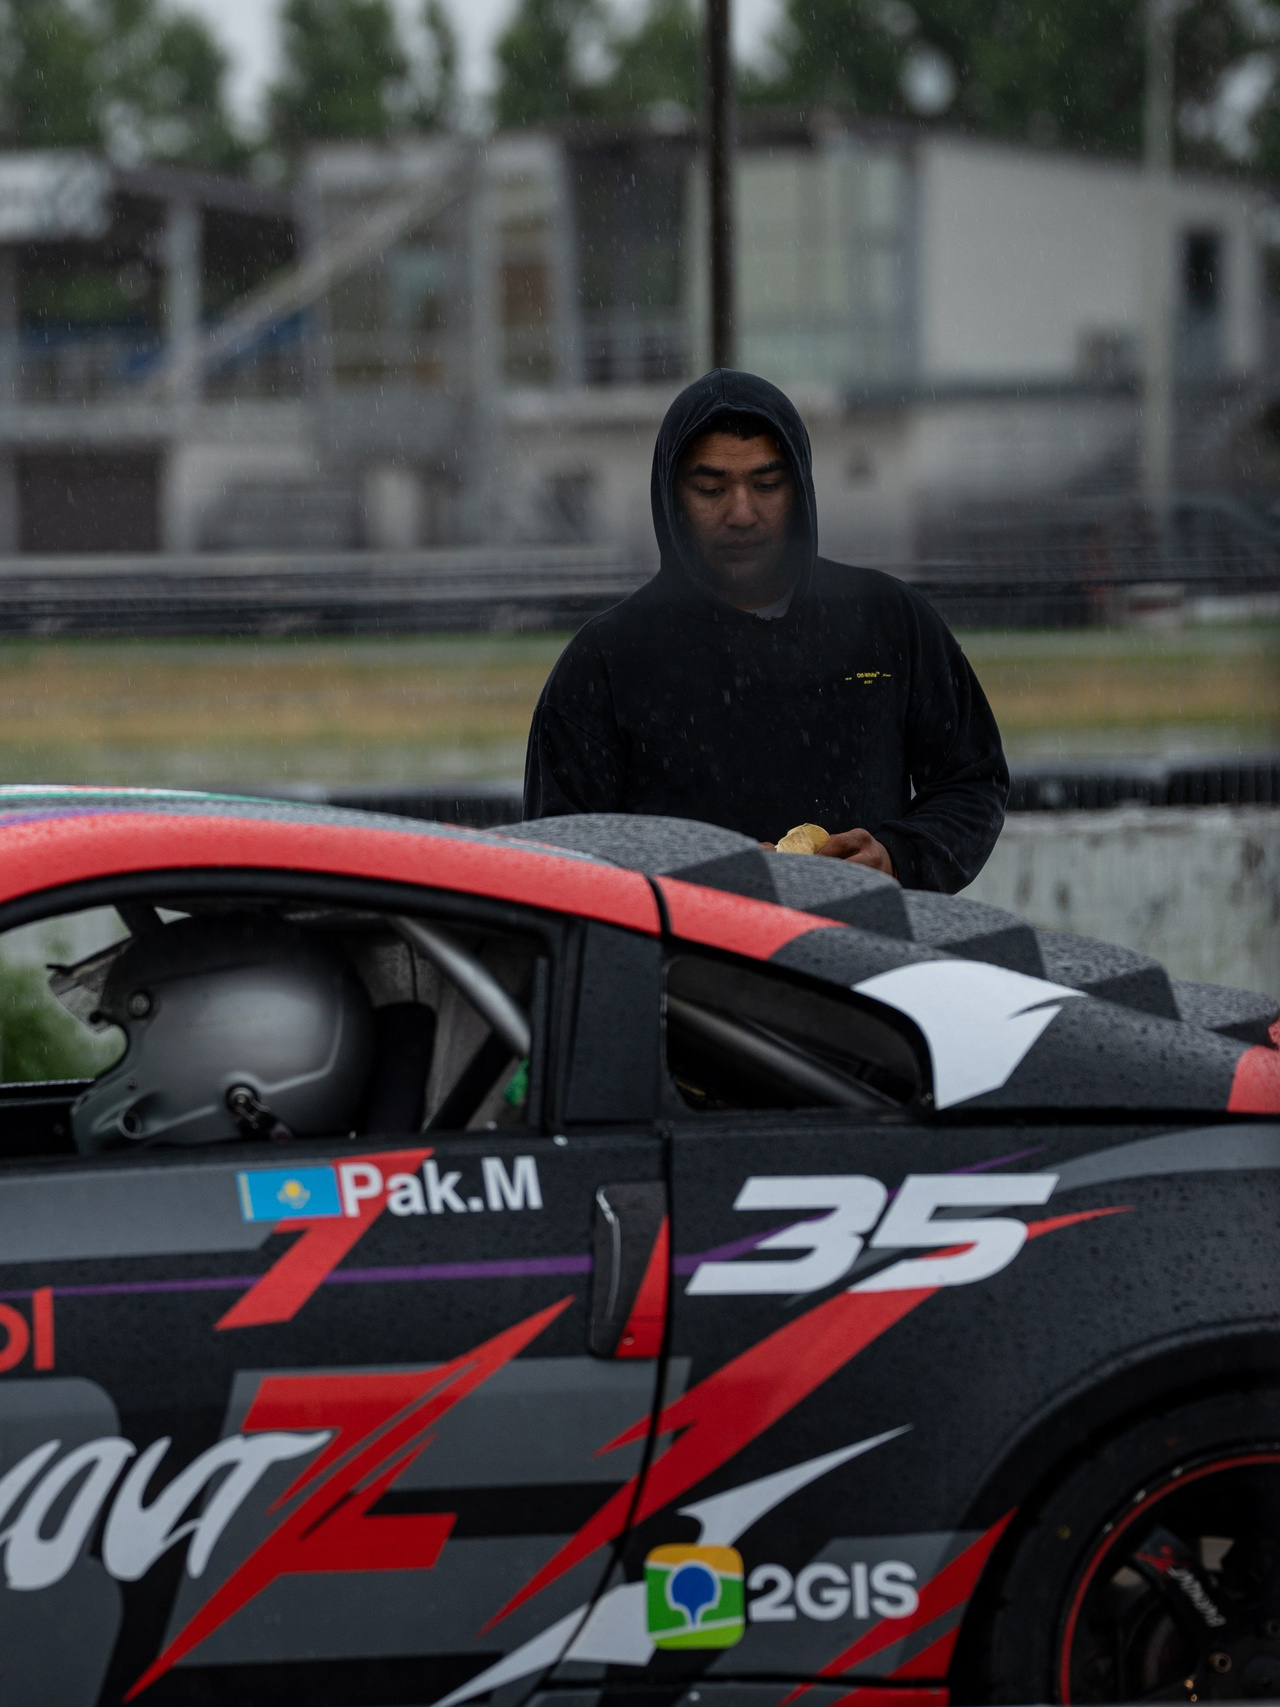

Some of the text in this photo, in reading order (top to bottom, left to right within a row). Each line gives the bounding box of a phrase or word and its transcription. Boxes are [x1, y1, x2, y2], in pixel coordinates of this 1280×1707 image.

[338, 1155, 544, 1218] Pak.M
[684, 1172, 1060, 1296] 35
[746, 1560, 920, 1622] 2GIS
